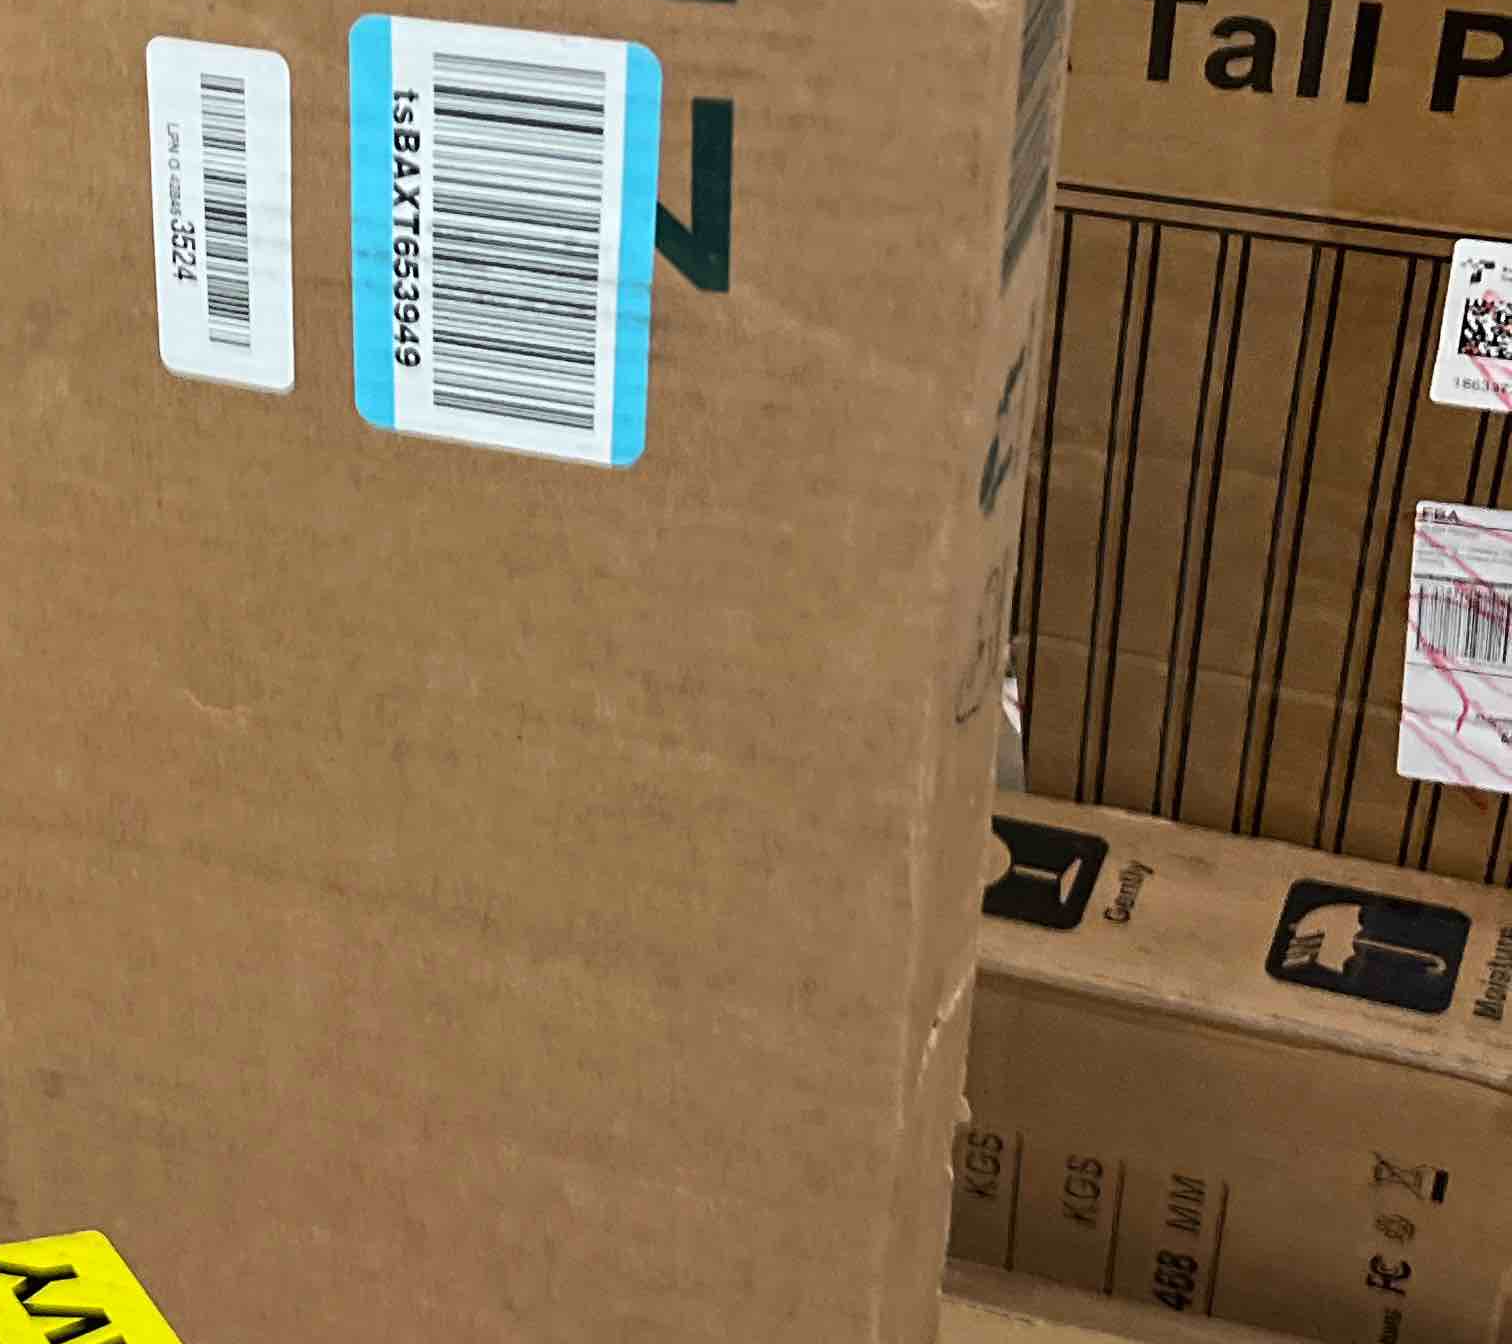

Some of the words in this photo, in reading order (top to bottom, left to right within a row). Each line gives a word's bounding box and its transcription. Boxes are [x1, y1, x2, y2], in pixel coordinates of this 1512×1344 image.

[170, 219, 198, 283] 3524
[391, 87, 423, 369] tsBAXT653949
[1103, 860, 1155, 927] Gently
[960, 1130, 1005, 1201] KGS
[1062, 1156, 1105, 1229] KGS
[1166, 1172, 1207, 1234] MM
